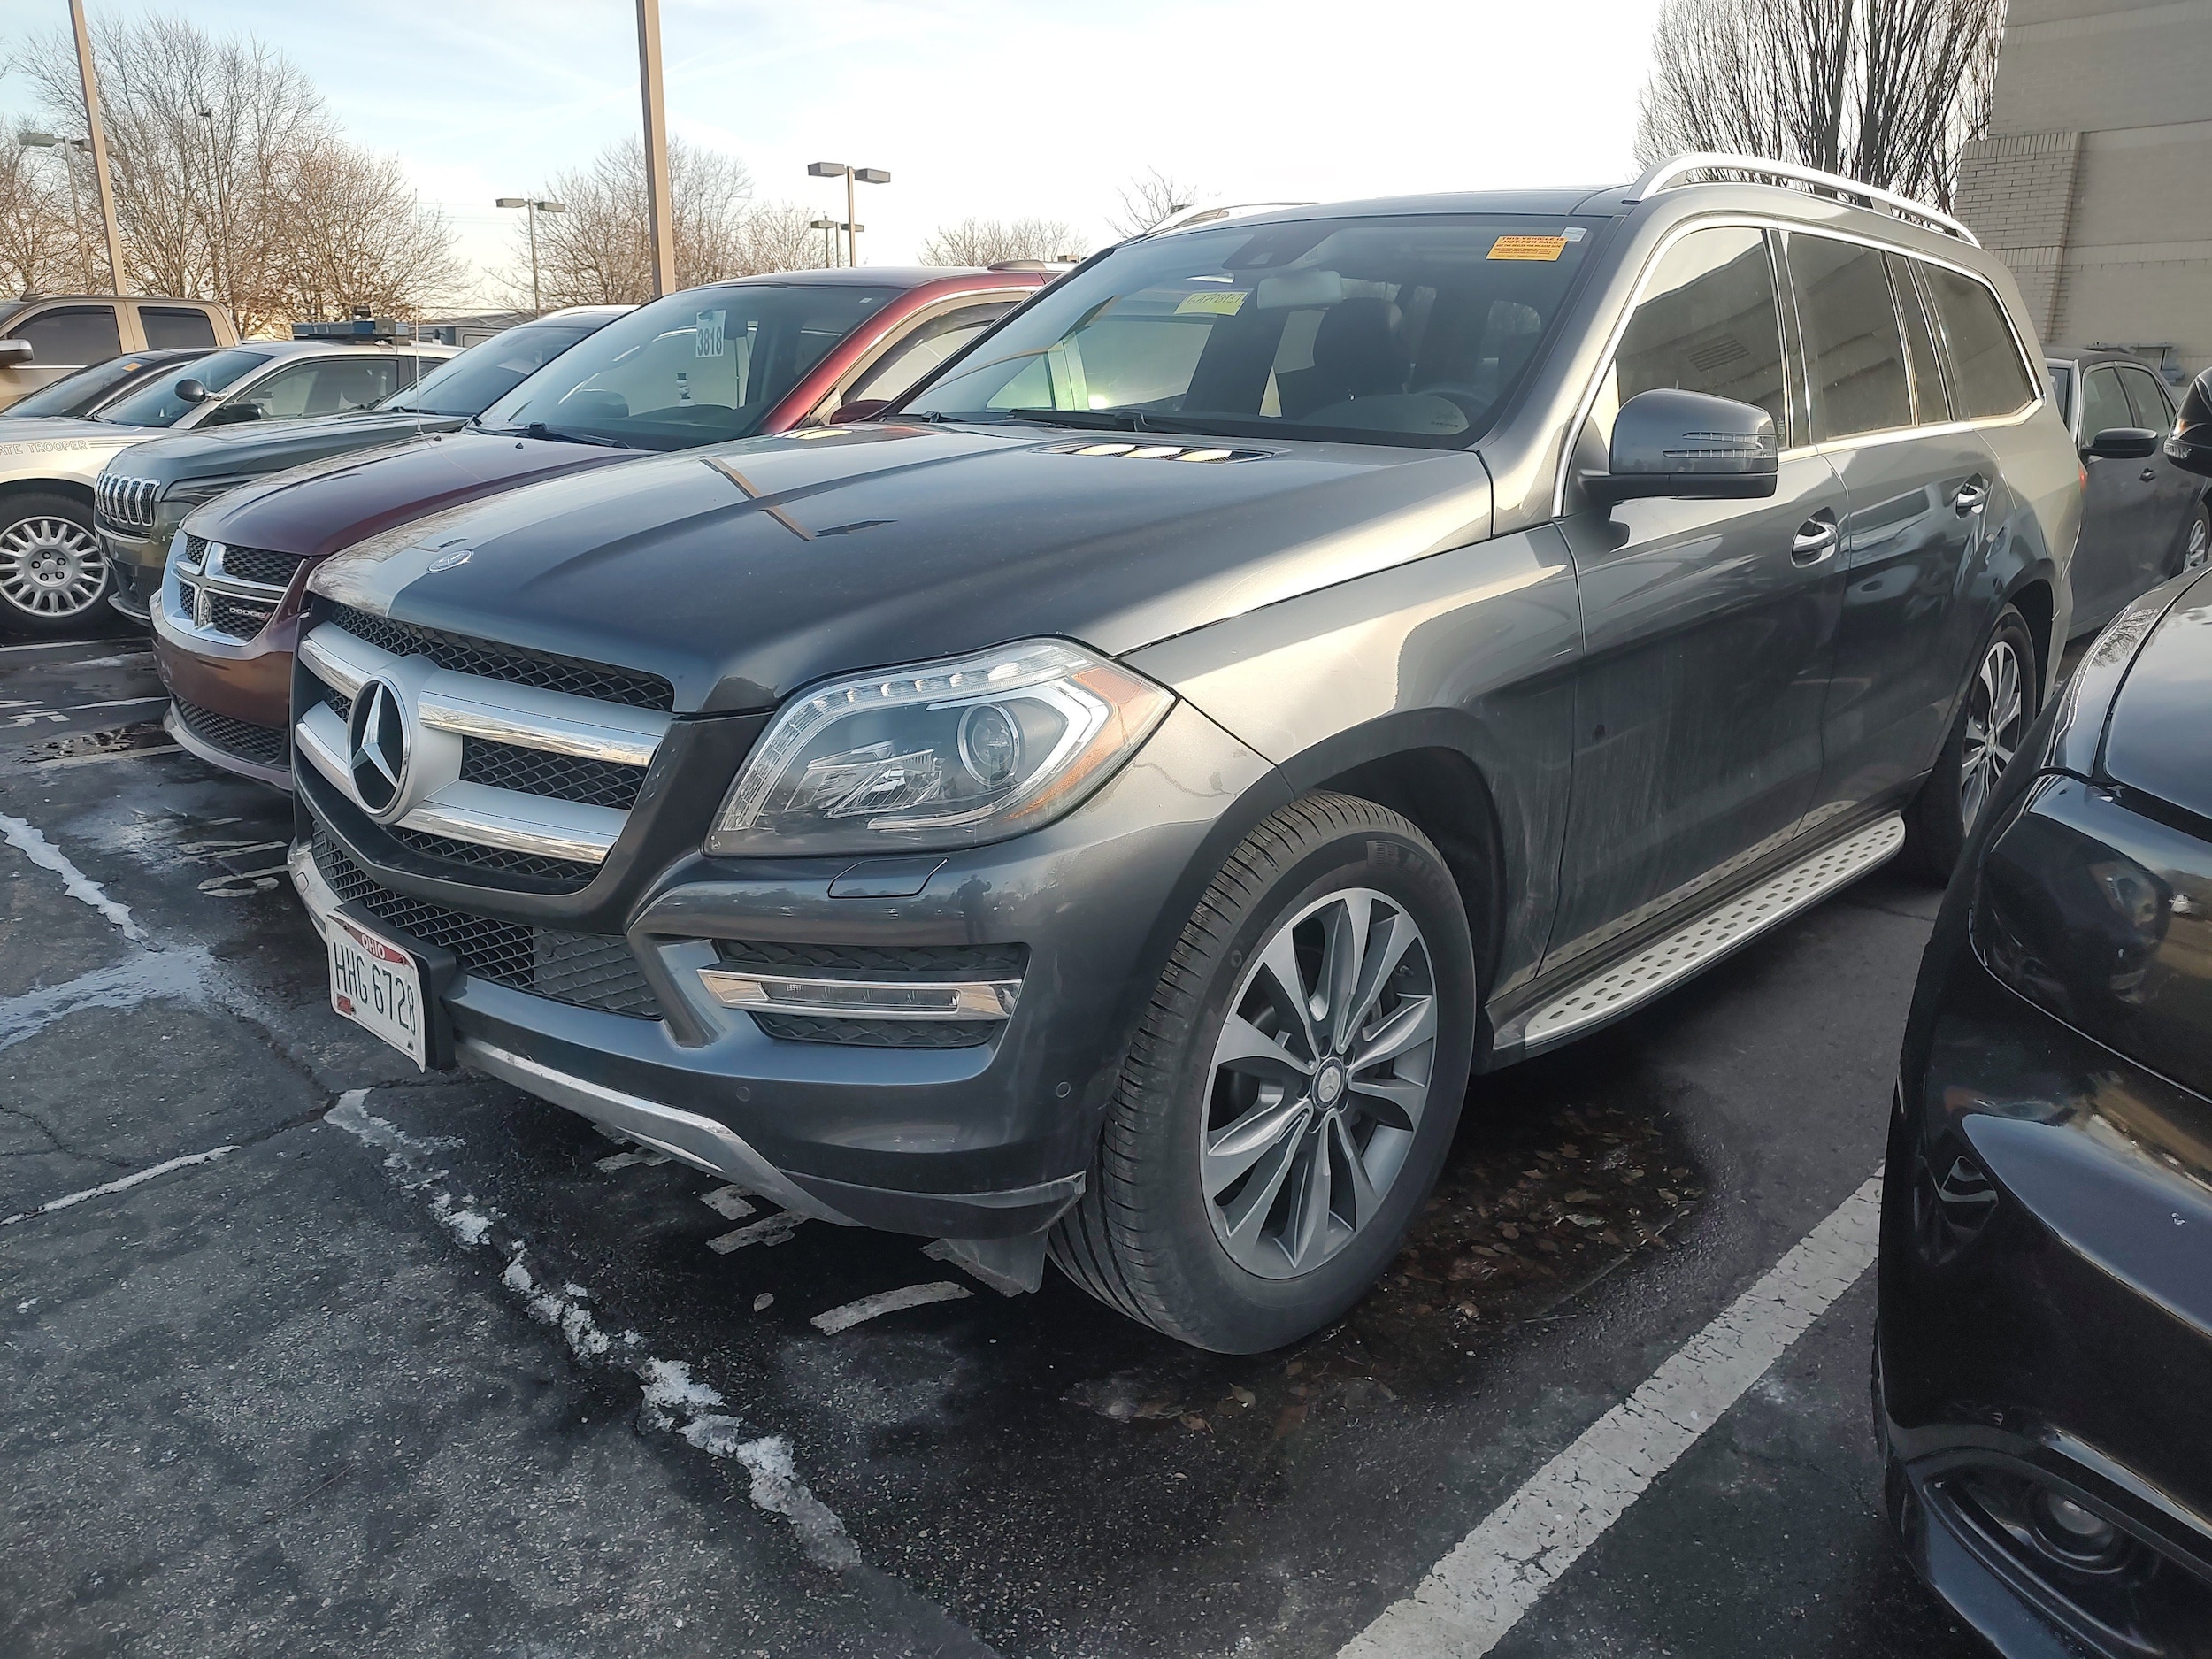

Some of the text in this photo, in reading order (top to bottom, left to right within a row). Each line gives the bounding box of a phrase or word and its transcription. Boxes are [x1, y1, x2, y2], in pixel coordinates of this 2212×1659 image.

[697, 326, 723, 357] 3818
[26, 440, 88, 453] TROOPER
[228, 607, 266, 619] DODGE
[361, 934, 386, 960] OHIO
[334, 941, 416, 1036] HHG 6728
